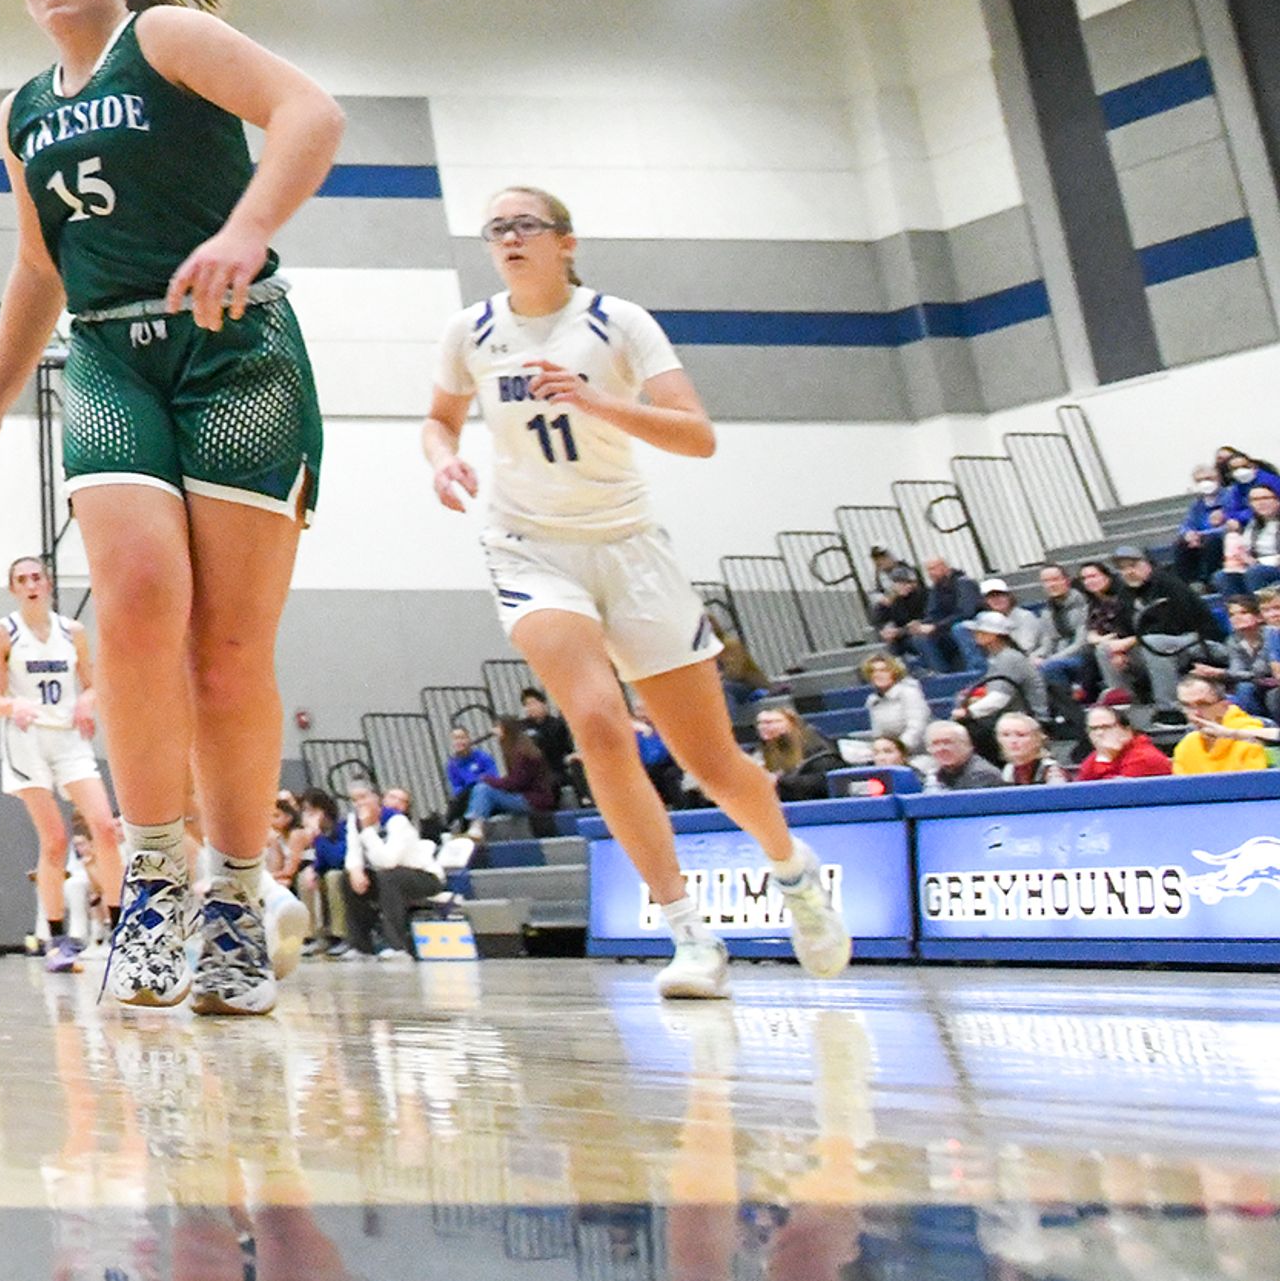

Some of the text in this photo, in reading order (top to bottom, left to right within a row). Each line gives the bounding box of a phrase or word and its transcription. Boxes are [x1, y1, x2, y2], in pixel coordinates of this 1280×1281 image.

[46, 156, 117, 222] 15
[526, 414, 579, 463] 11
[37, 679, 62, 705] 10
[921, 867, 1186, 919] GREYHOUNDS
